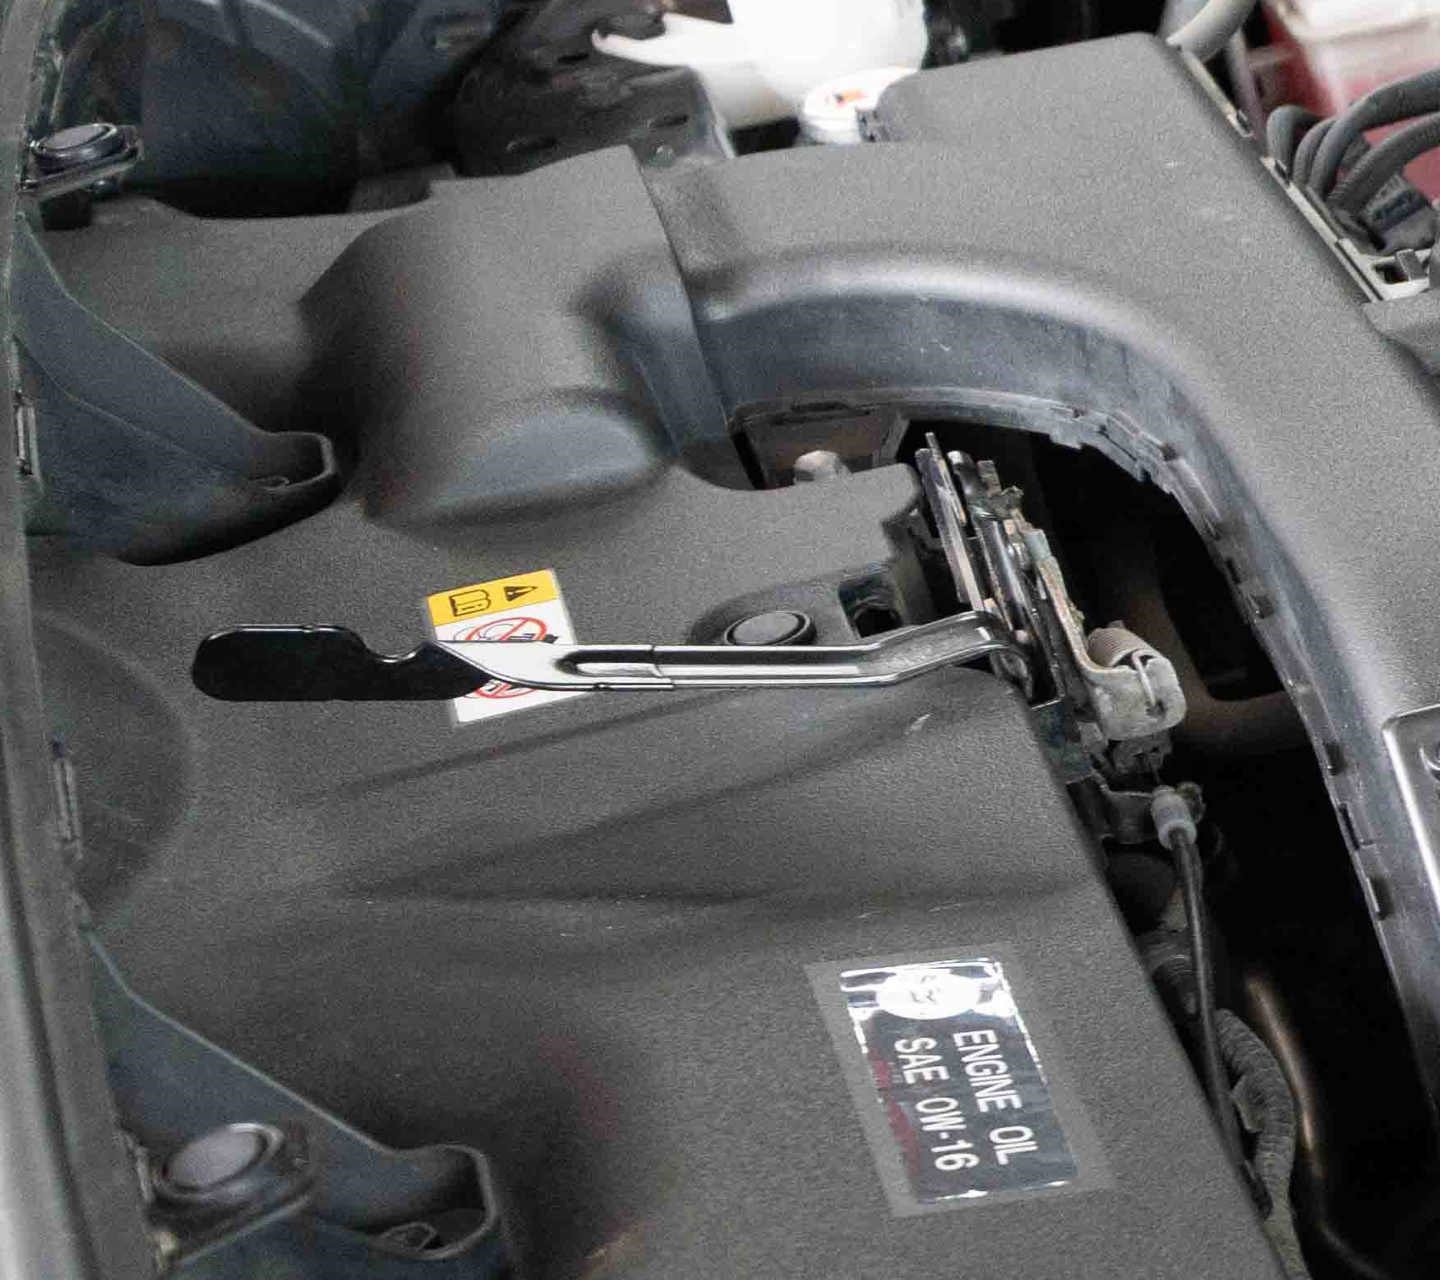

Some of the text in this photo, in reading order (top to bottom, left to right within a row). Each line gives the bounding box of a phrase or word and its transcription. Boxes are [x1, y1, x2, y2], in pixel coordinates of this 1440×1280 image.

[893, 1036, 950, 1085] SAE
[951, 1028, 1039, 1166] ENGINE OIL
